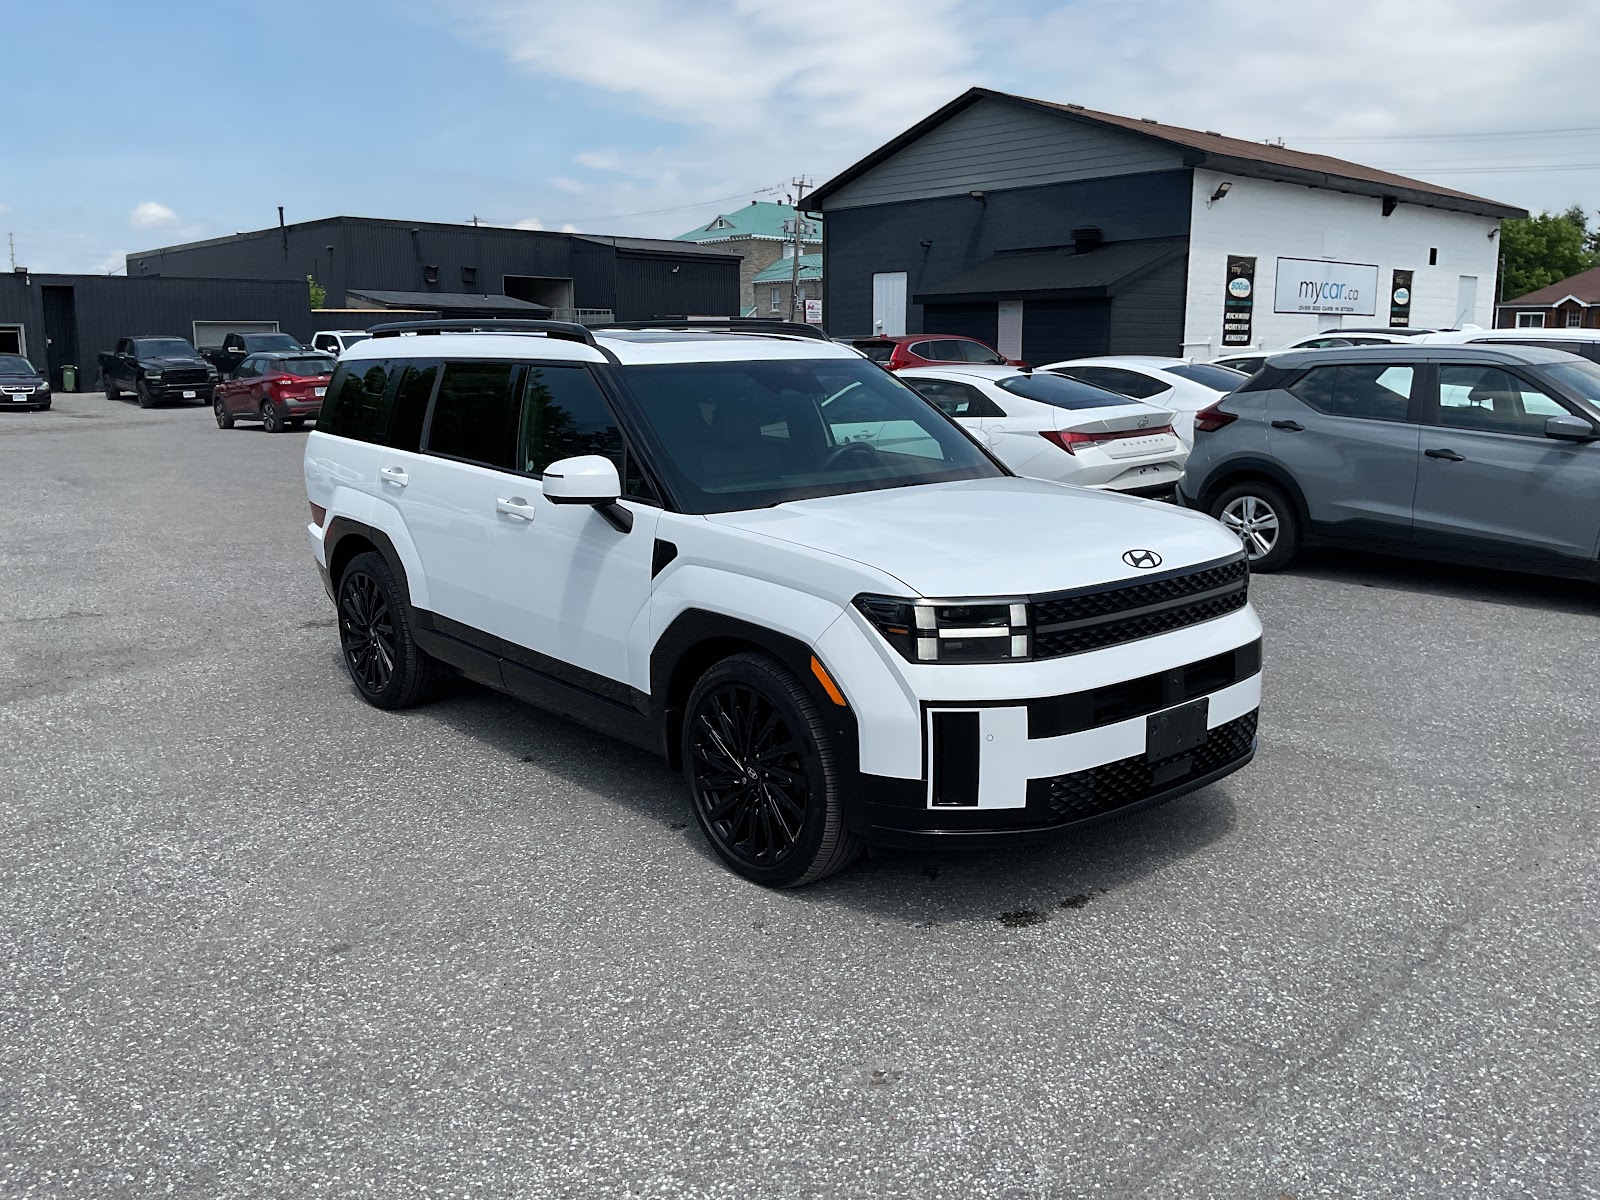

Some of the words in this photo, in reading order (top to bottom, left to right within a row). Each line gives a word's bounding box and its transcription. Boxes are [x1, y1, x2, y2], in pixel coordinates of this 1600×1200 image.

[1298, 280, 1359, 304] mycar.ca
[1225, 312, 1250, 320] RICHMOND
[1224, 323, 1241, 331] NORTH
[1122, 438, 1164, 446] ELANTRA
